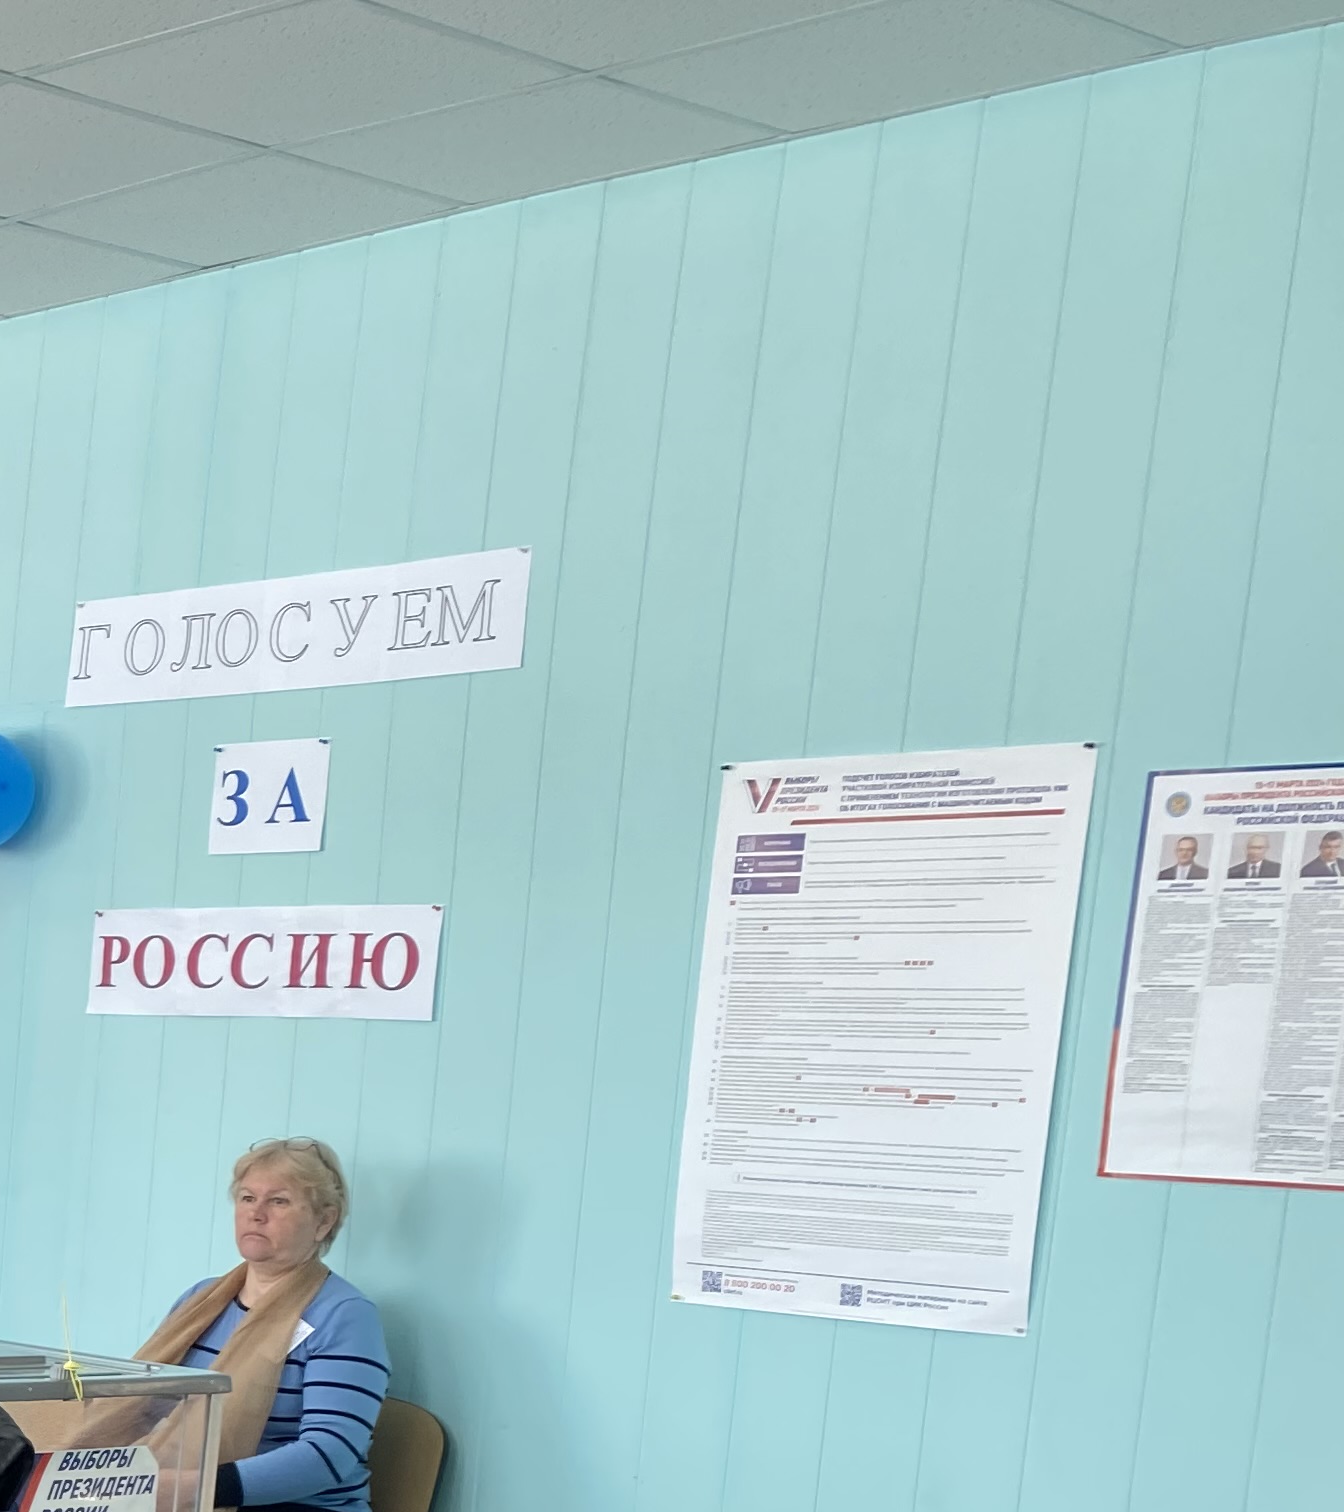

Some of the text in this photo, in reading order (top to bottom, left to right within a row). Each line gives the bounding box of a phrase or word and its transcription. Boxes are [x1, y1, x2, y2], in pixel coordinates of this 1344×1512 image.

[73, 578, 502, 682] ГОЛОСУЕМ
[216, 767, 313, 827] ЗА
[95, 931, 422, 992] РОССИЮ
[46, 1474, 156, 1501] ПРЕЗИДЕНТА
[57, 1447, 137, 1472] ВЫБОРЫ
